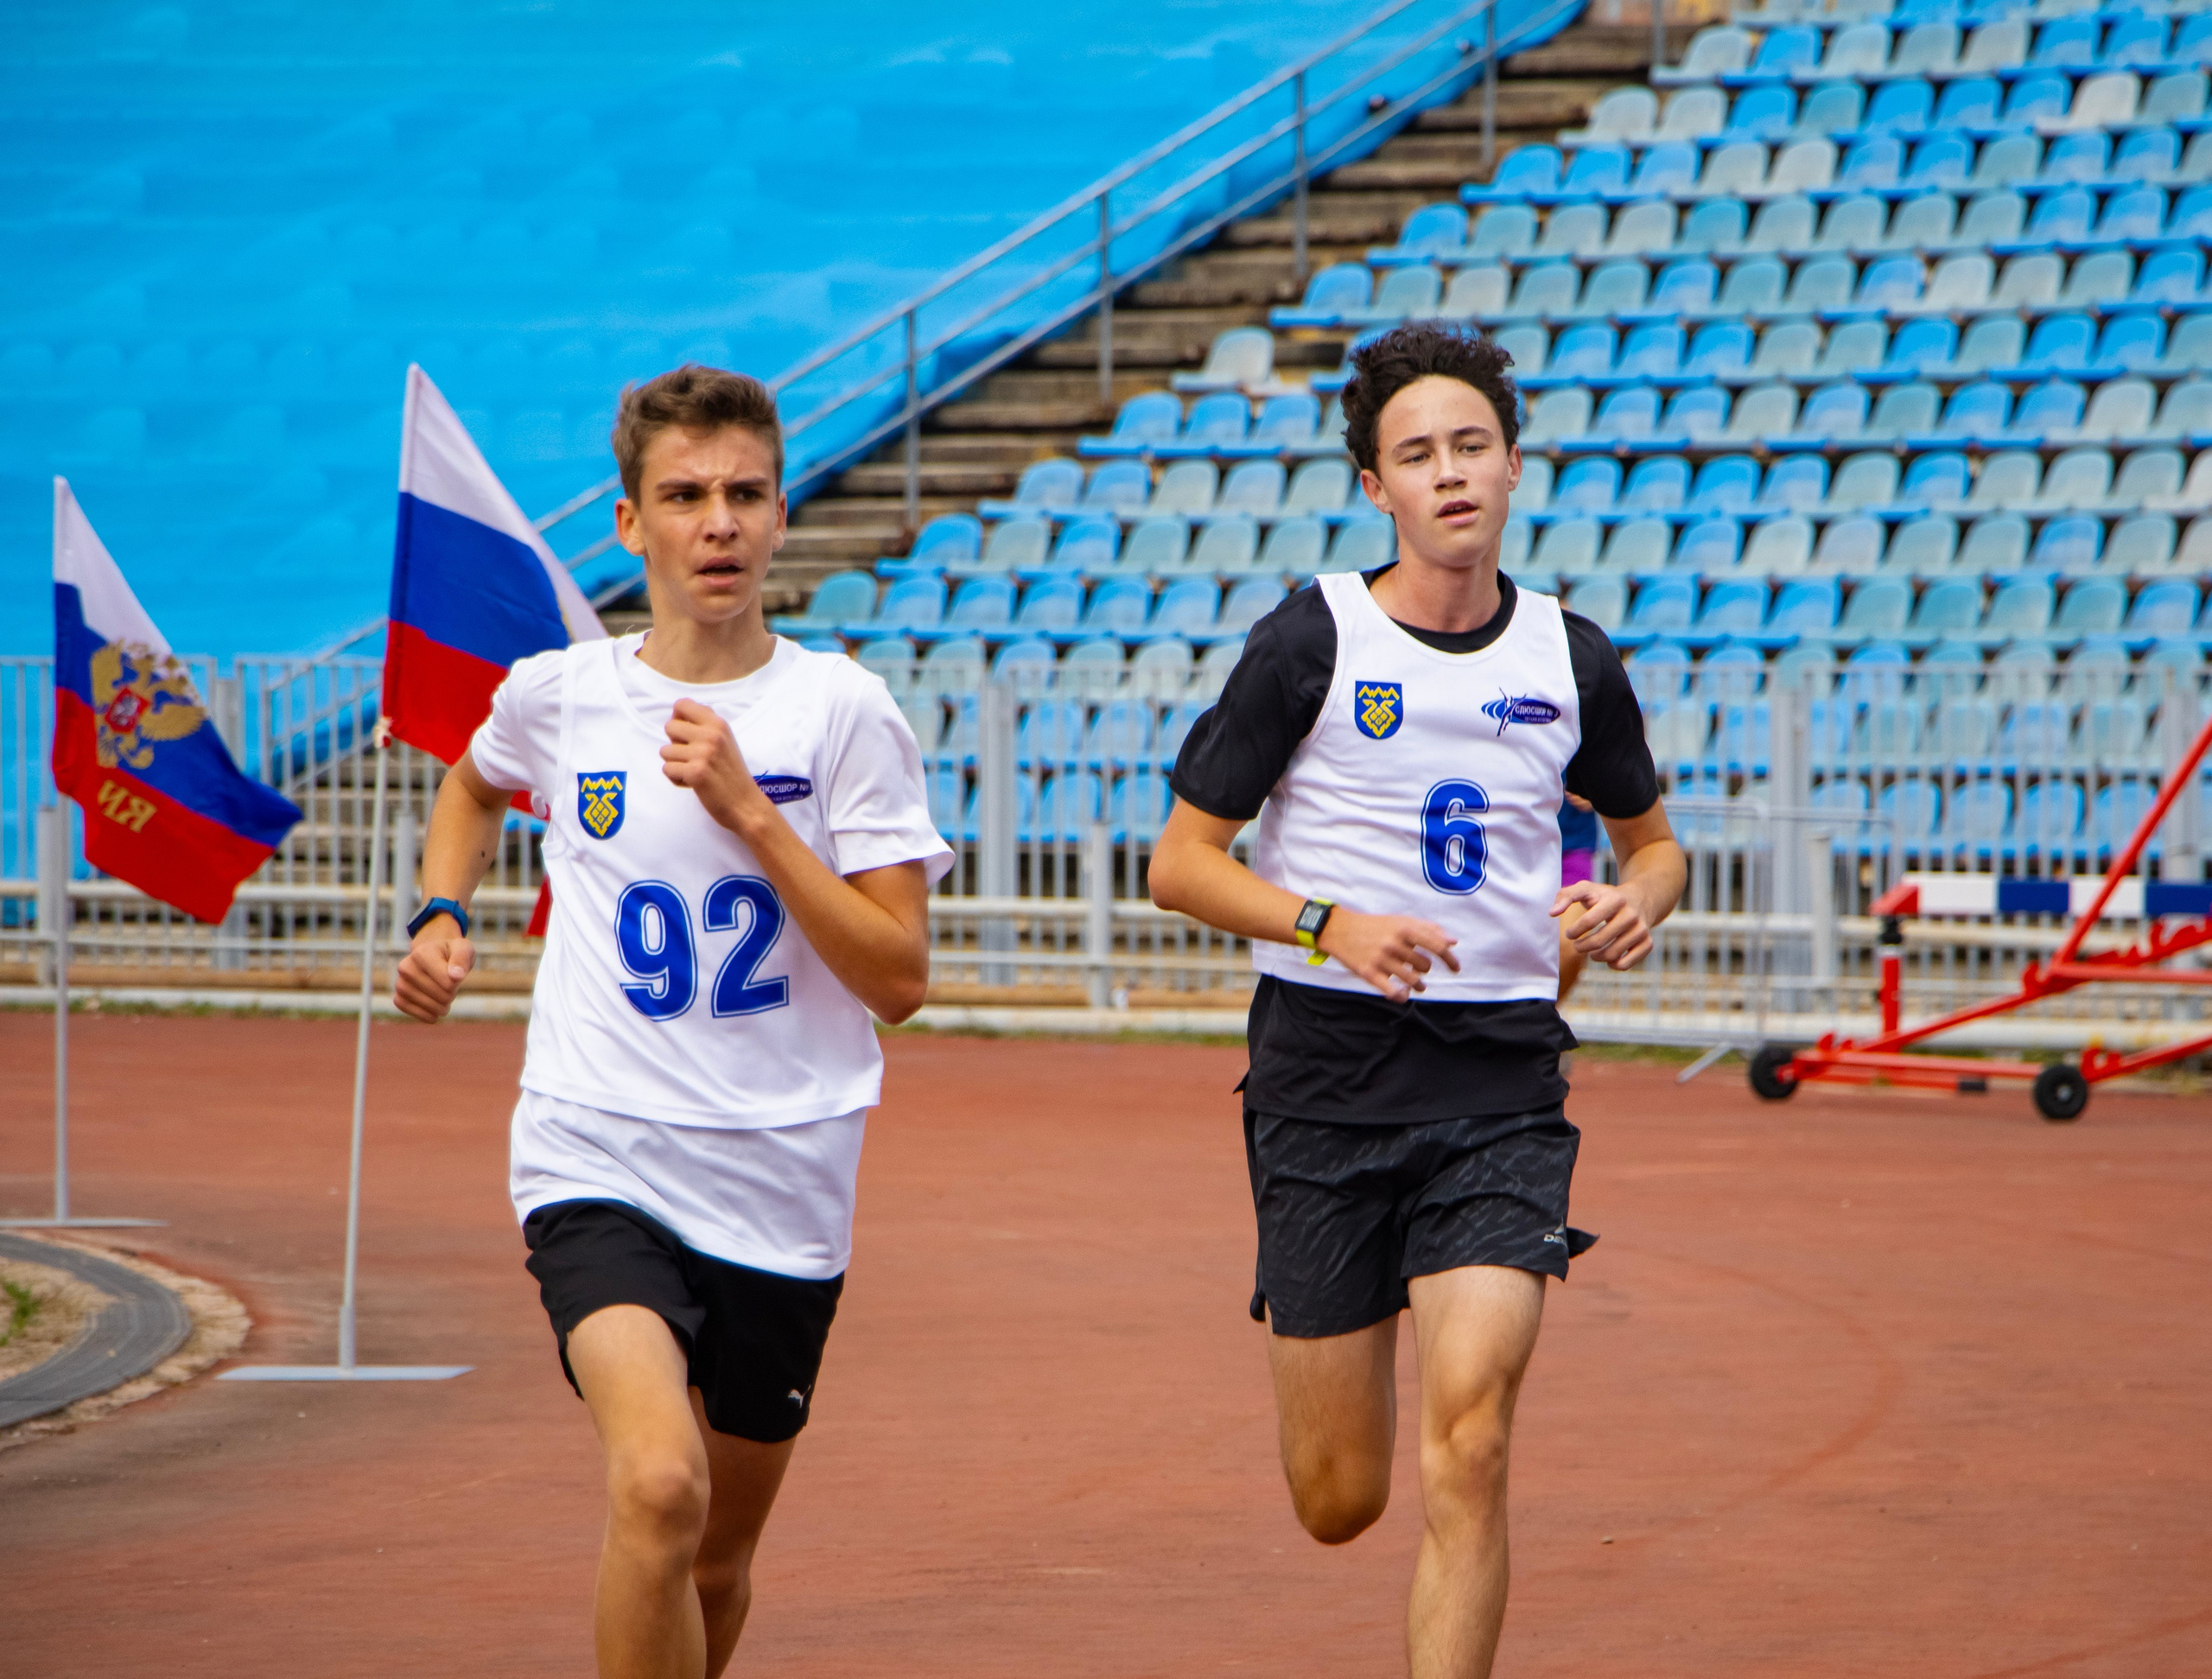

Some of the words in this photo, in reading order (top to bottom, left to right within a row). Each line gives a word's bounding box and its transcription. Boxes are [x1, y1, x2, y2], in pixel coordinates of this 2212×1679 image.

[97, 779, 158, 834] ИЯ
[759, 783, 798, 794] ДЮСШОР
[1421, 778, 1491, 895] 6
[613, 874, 790, 1022] 92
